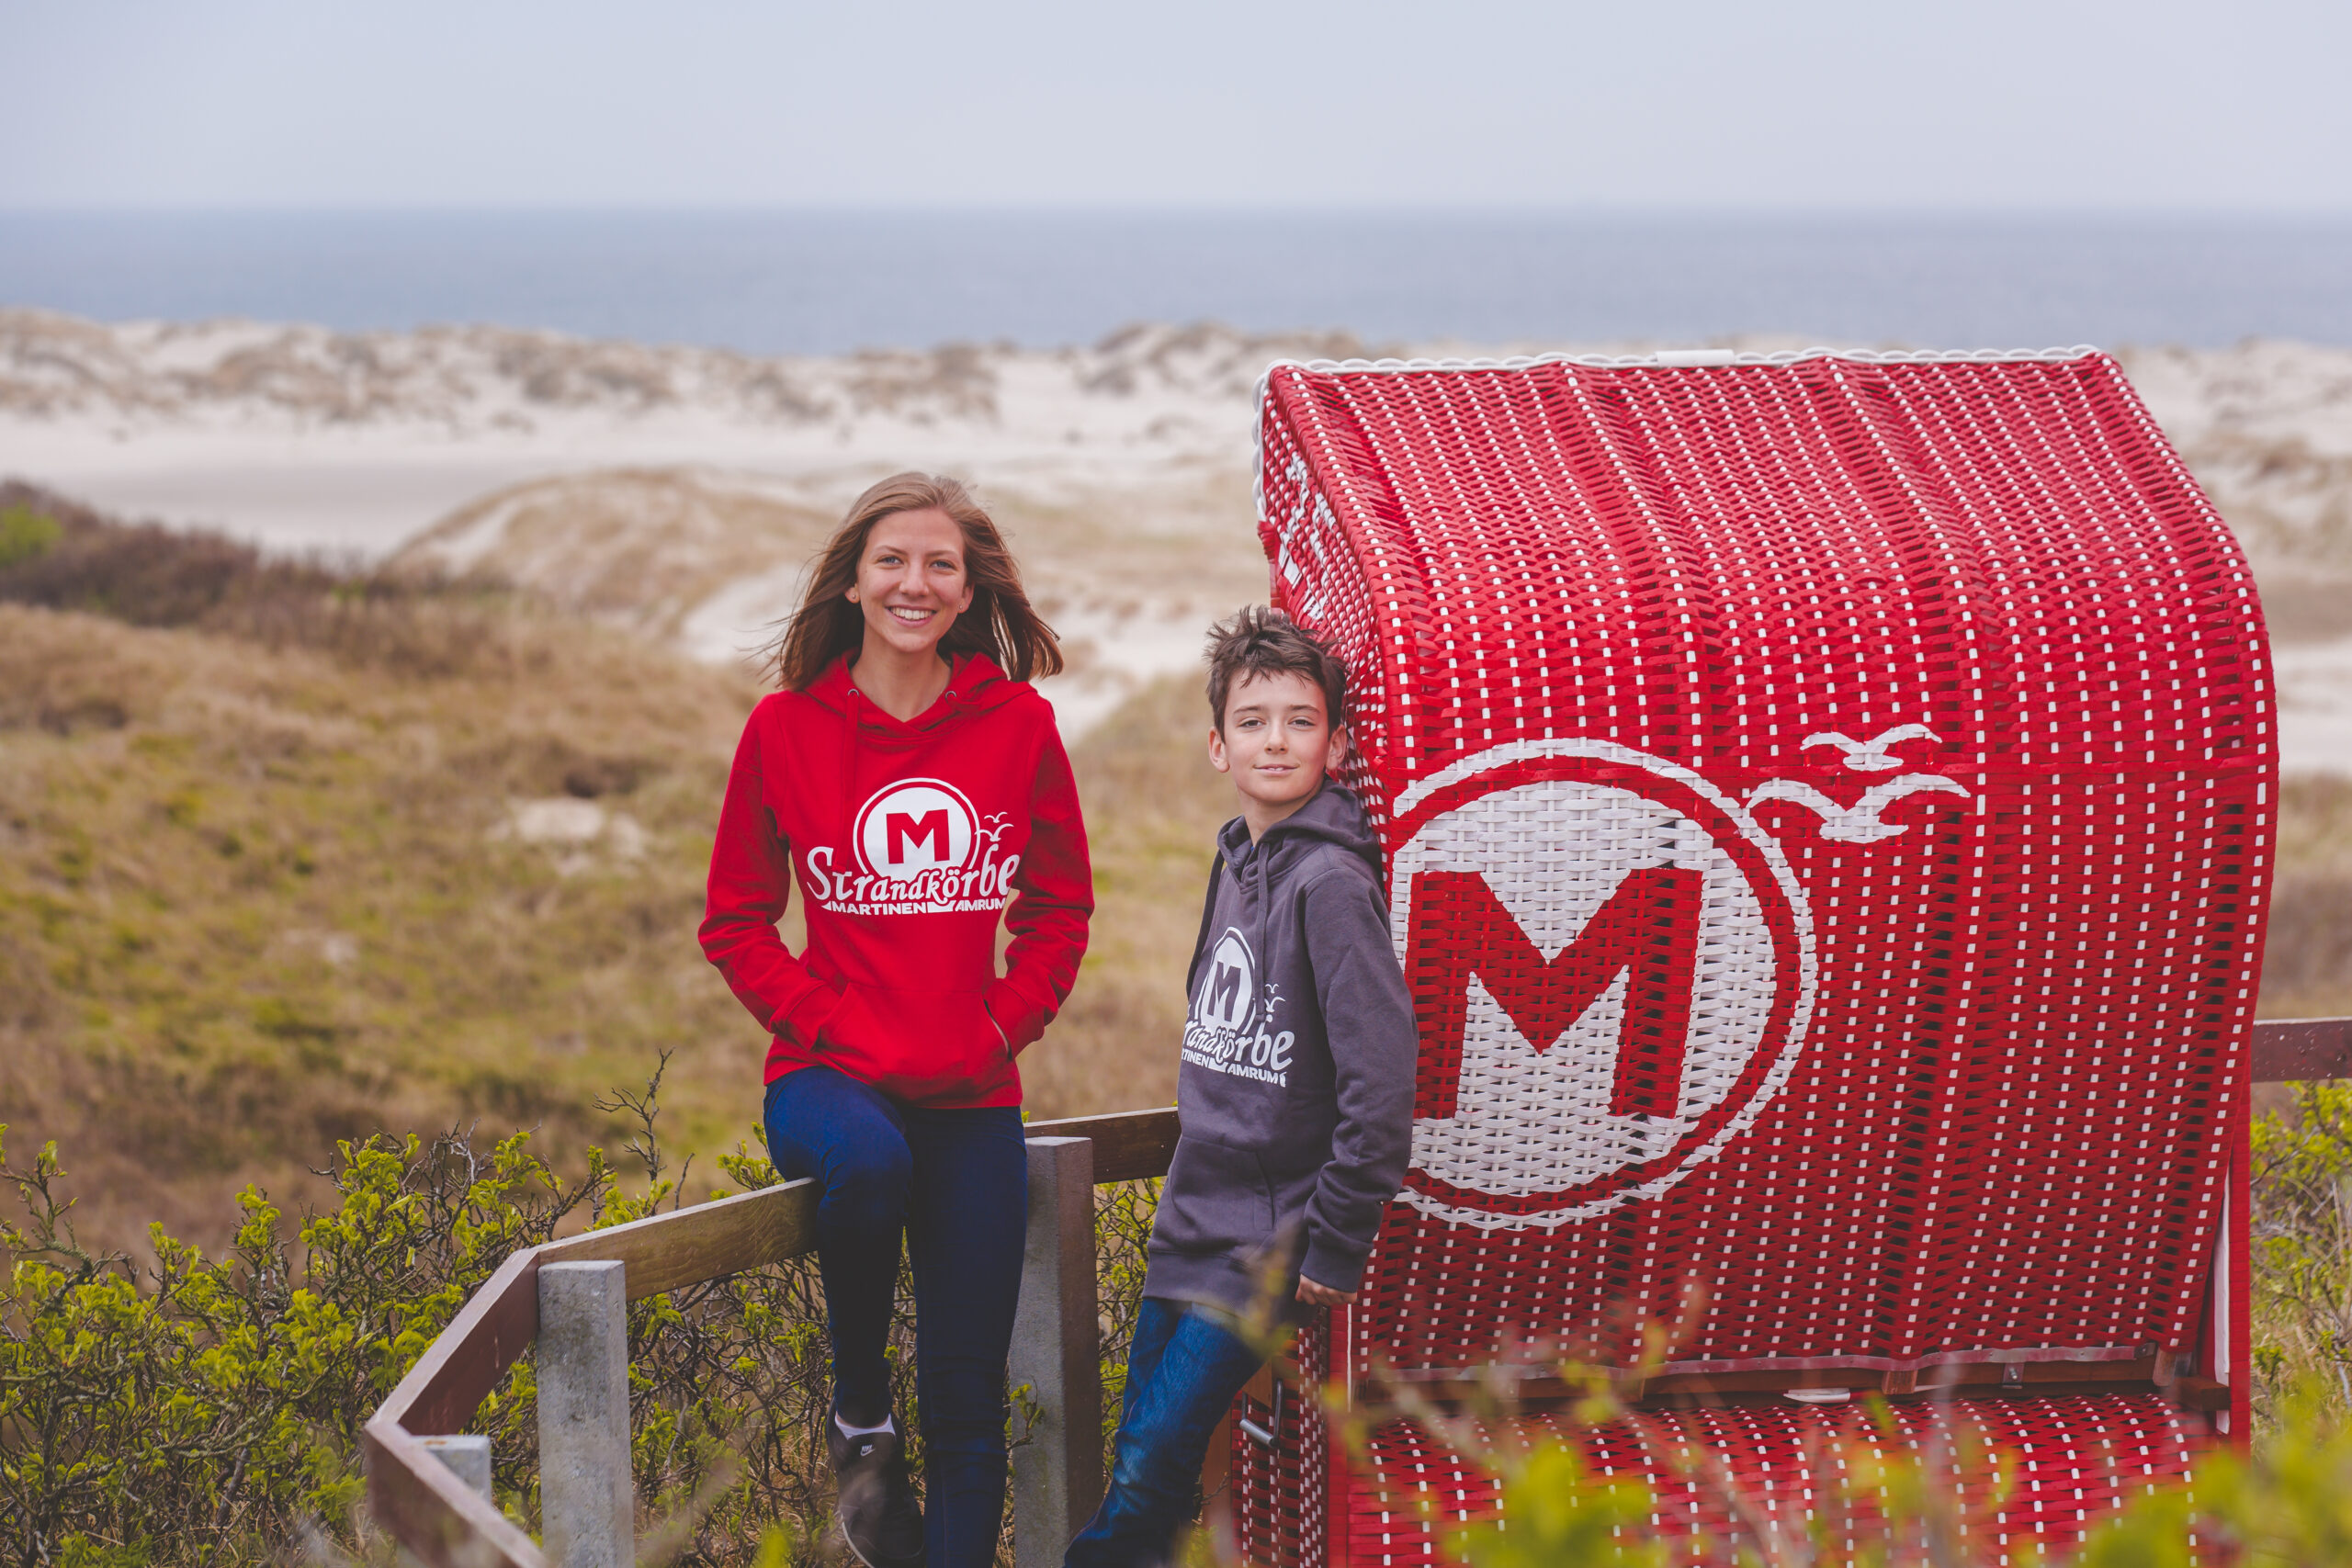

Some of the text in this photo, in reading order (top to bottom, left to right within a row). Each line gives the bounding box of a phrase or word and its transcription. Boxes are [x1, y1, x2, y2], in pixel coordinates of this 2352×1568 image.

[886, 808, 950, 864] M
[807, 843, 1020, 904] Strandkörbe
[831, 897, 1007, 916] MARTINEN AMRUM
[1206, 961, 1241, 1022] M
[1408, 867, 1702, 1120] M
[1182, 1014, 1295, 1071] randkörbe
[1227, 1063, 1278, 1084] AMRUM
